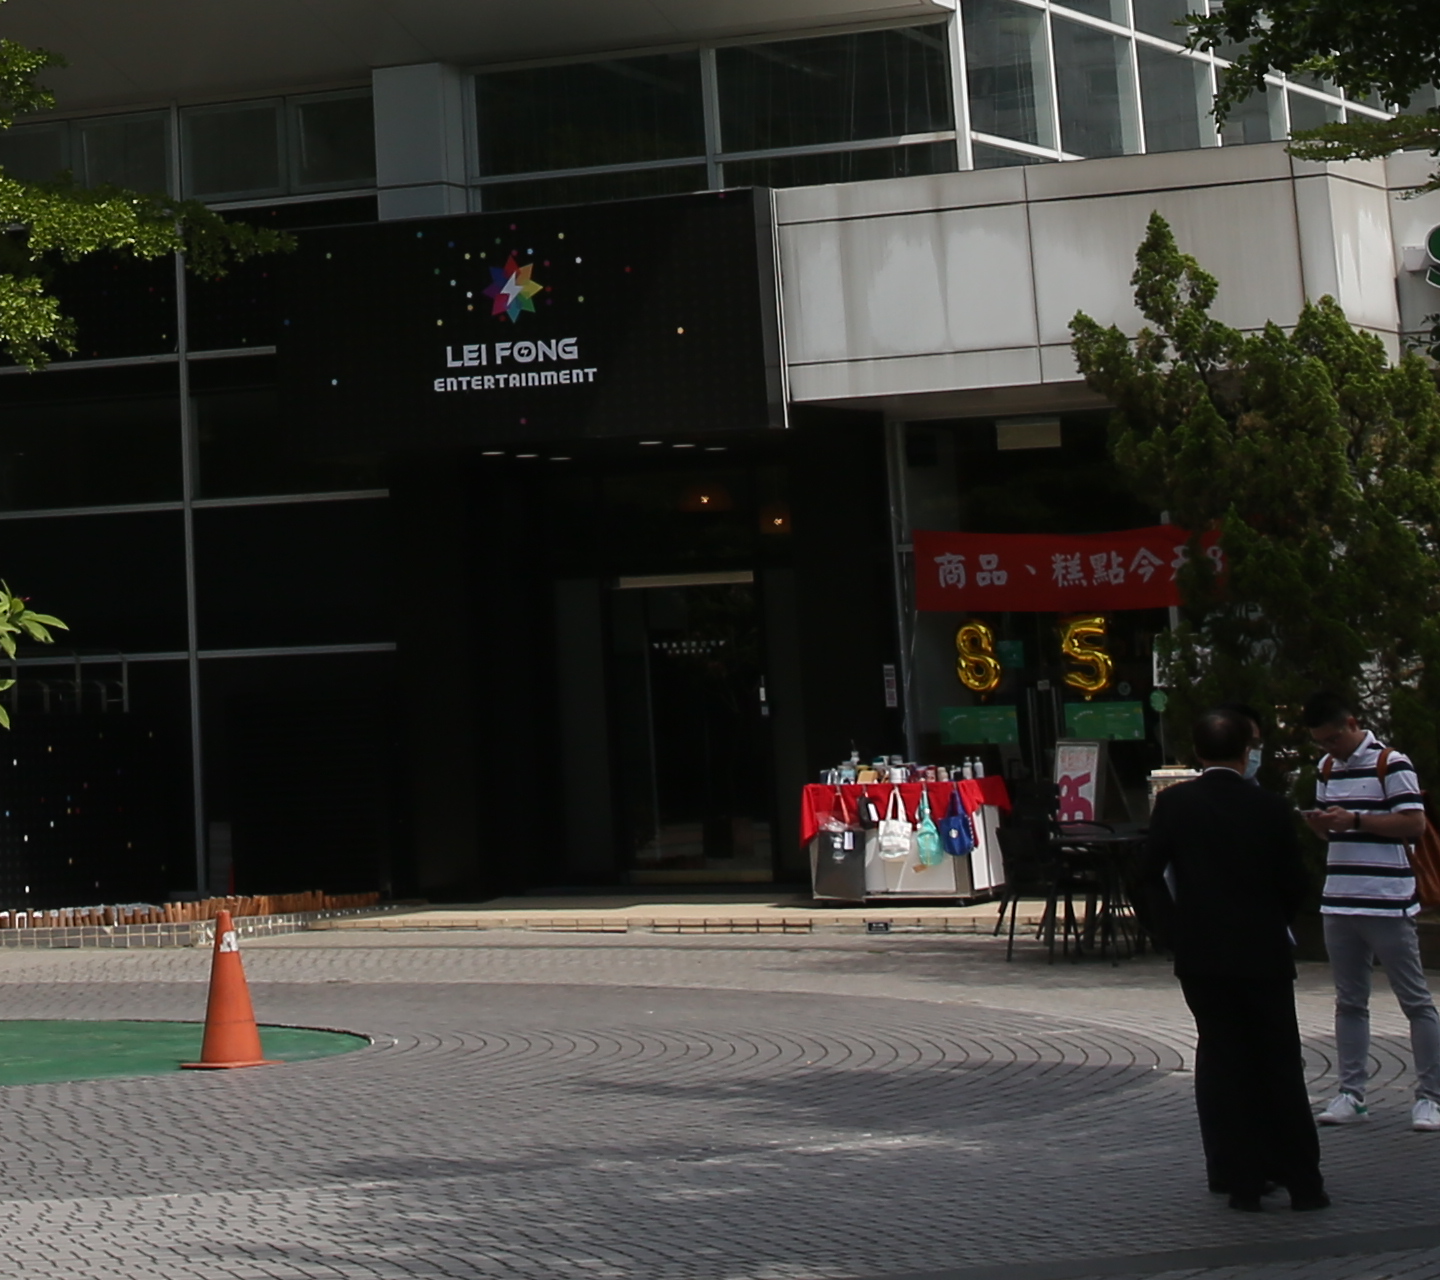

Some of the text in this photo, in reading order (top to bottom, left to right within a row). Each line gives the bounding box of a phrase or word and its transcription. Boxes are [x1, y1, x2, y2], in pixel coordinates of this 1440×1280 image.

[446, 337, 579, 368] LEI FONG
[433, 367, 598, 392] ENTERTAINMENT
[956, 621, 1002, 691] 8
[1061, 615, 1114, 692] 5
